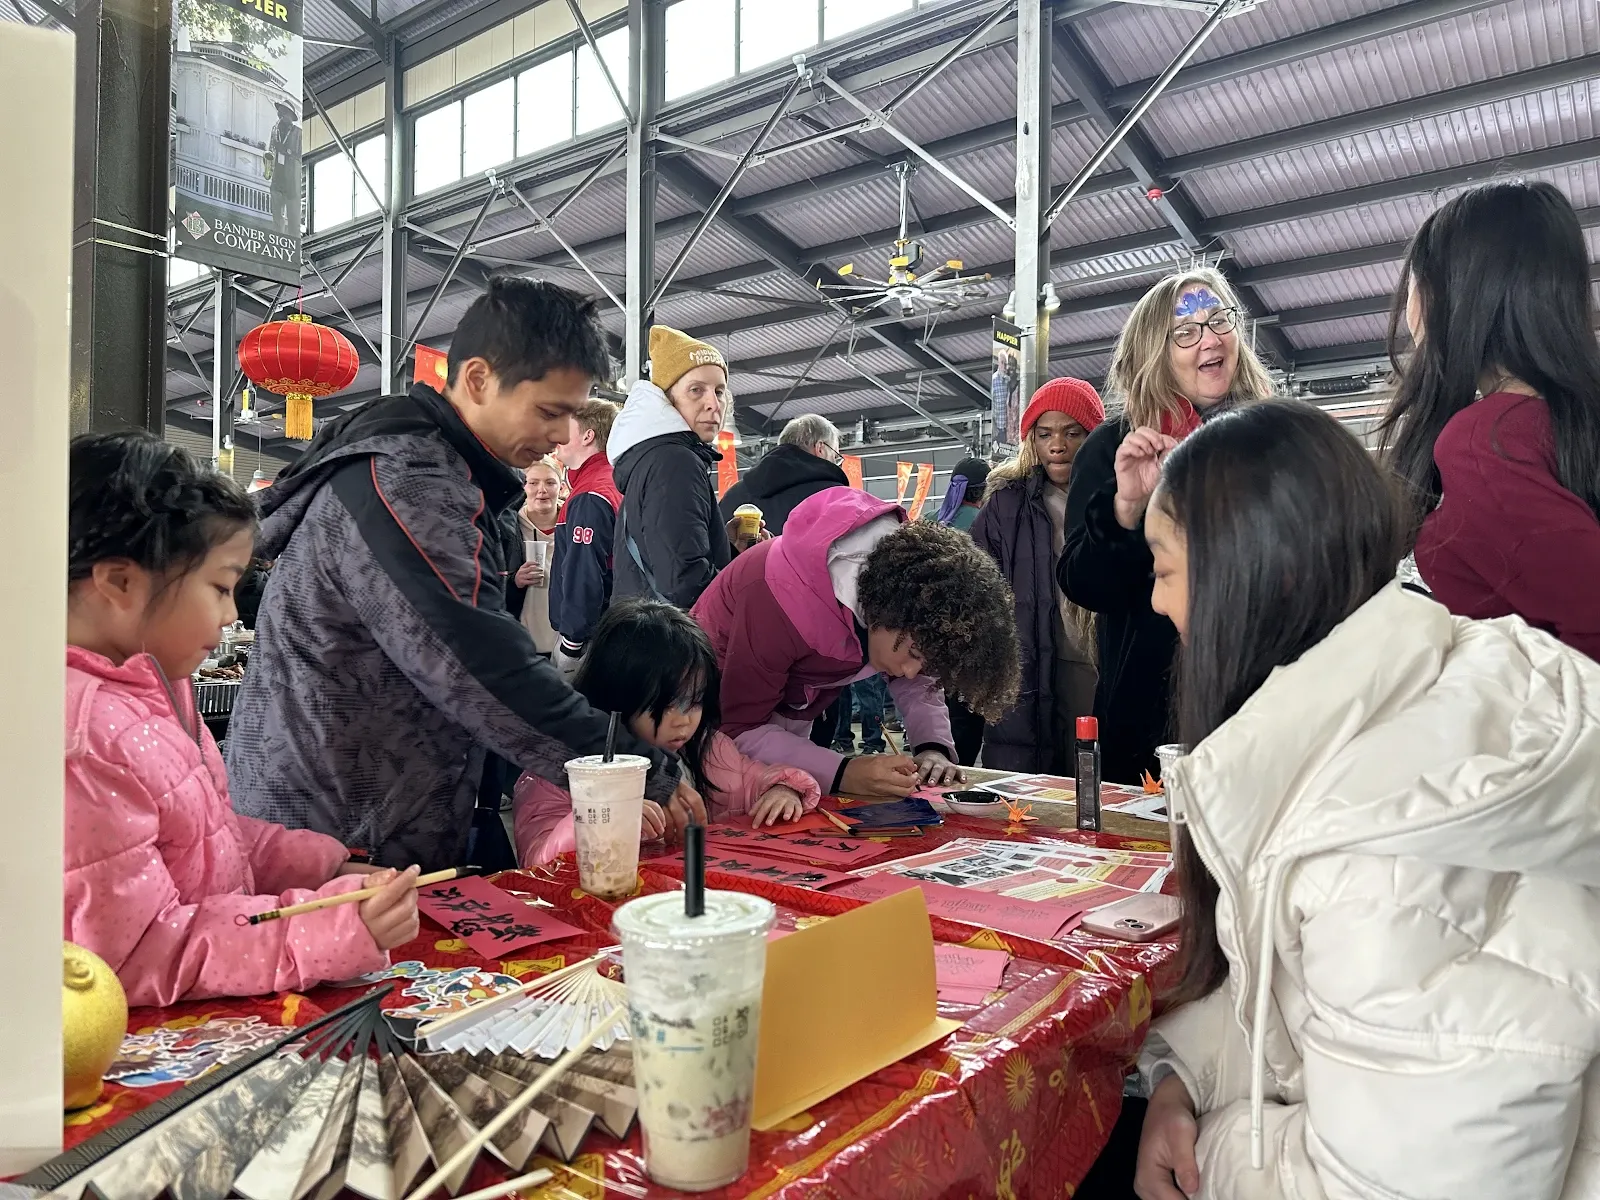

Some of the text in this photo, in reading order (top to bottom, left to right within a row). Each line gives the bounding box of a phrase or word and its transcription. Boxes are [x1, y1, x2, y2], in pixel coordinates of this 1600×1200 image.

[241, 0, 288, 22] IER
[214, 219, 297, 250] BANNER SIGN
[213, 231, 296, 262] COMPANY
[996, 330, 1018, 347] HAPPIER
[573, 526, 594, 545] 98
